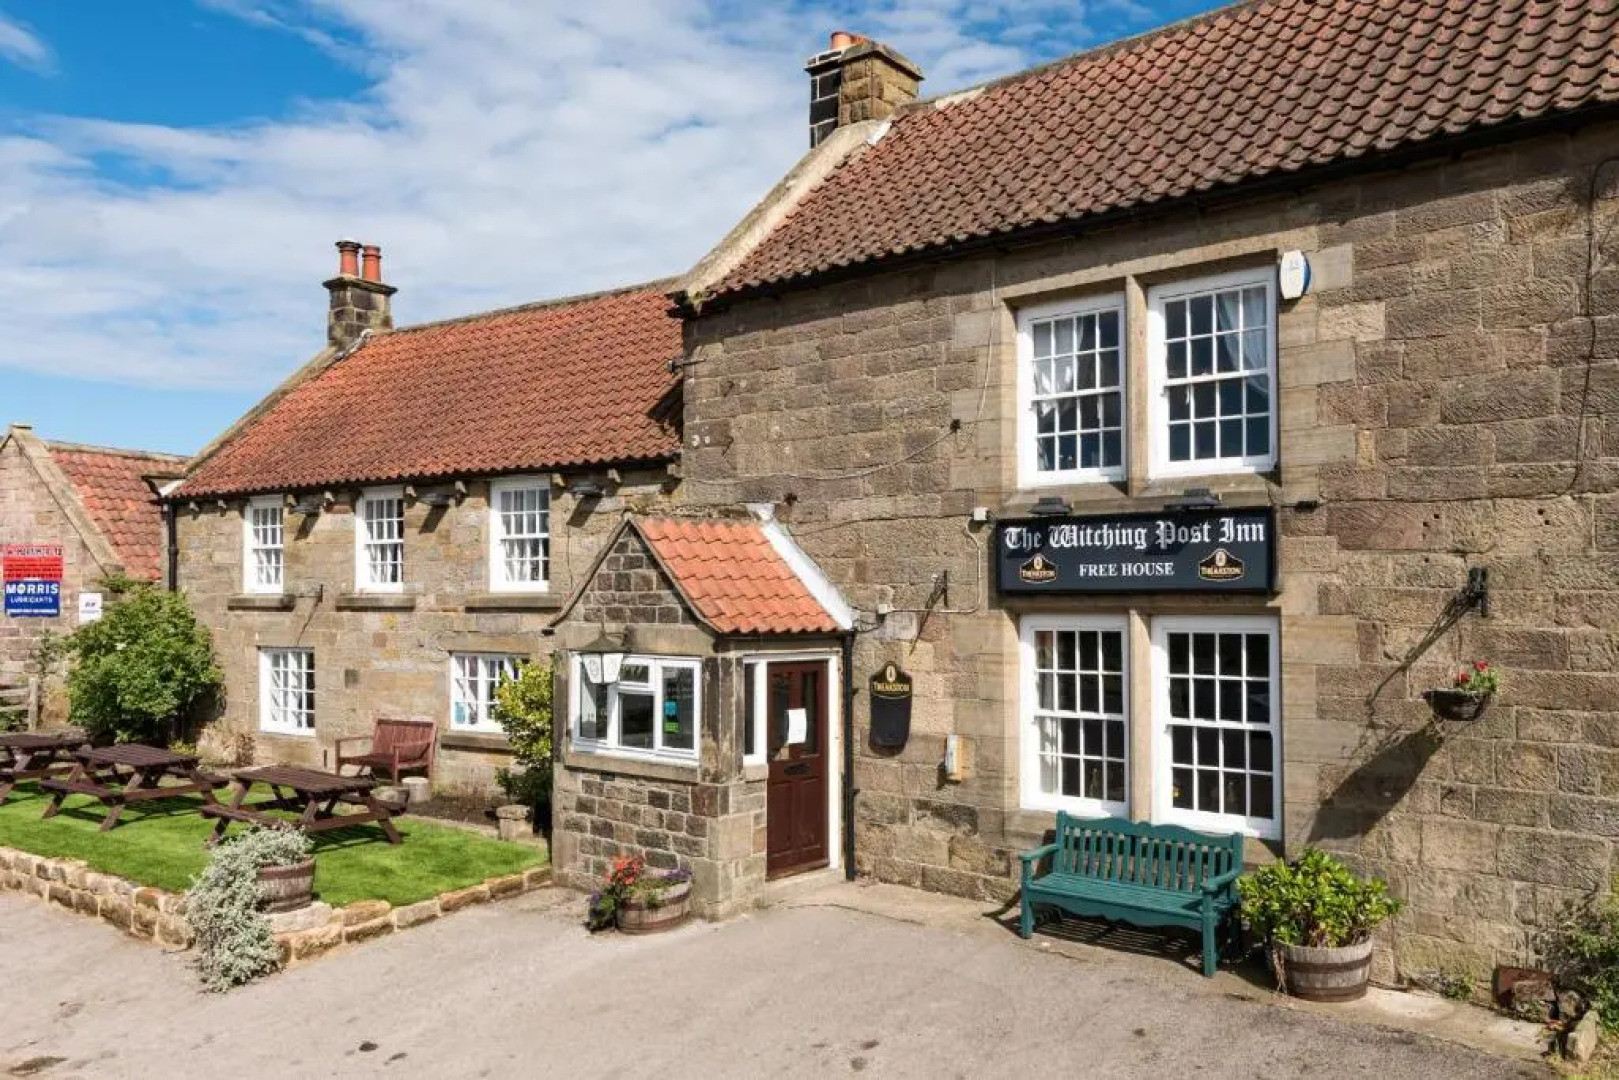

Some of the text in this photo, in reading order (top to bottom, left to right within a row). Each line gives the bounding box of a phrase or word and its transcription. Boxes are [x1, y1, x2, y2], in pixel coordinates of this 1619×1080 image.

[1005, 517, 1265, 550] The Witching Post Inn
[1079, 562, 1175, 577] FREE HOUSE
[5, 583, 58, 594] MORRIS
